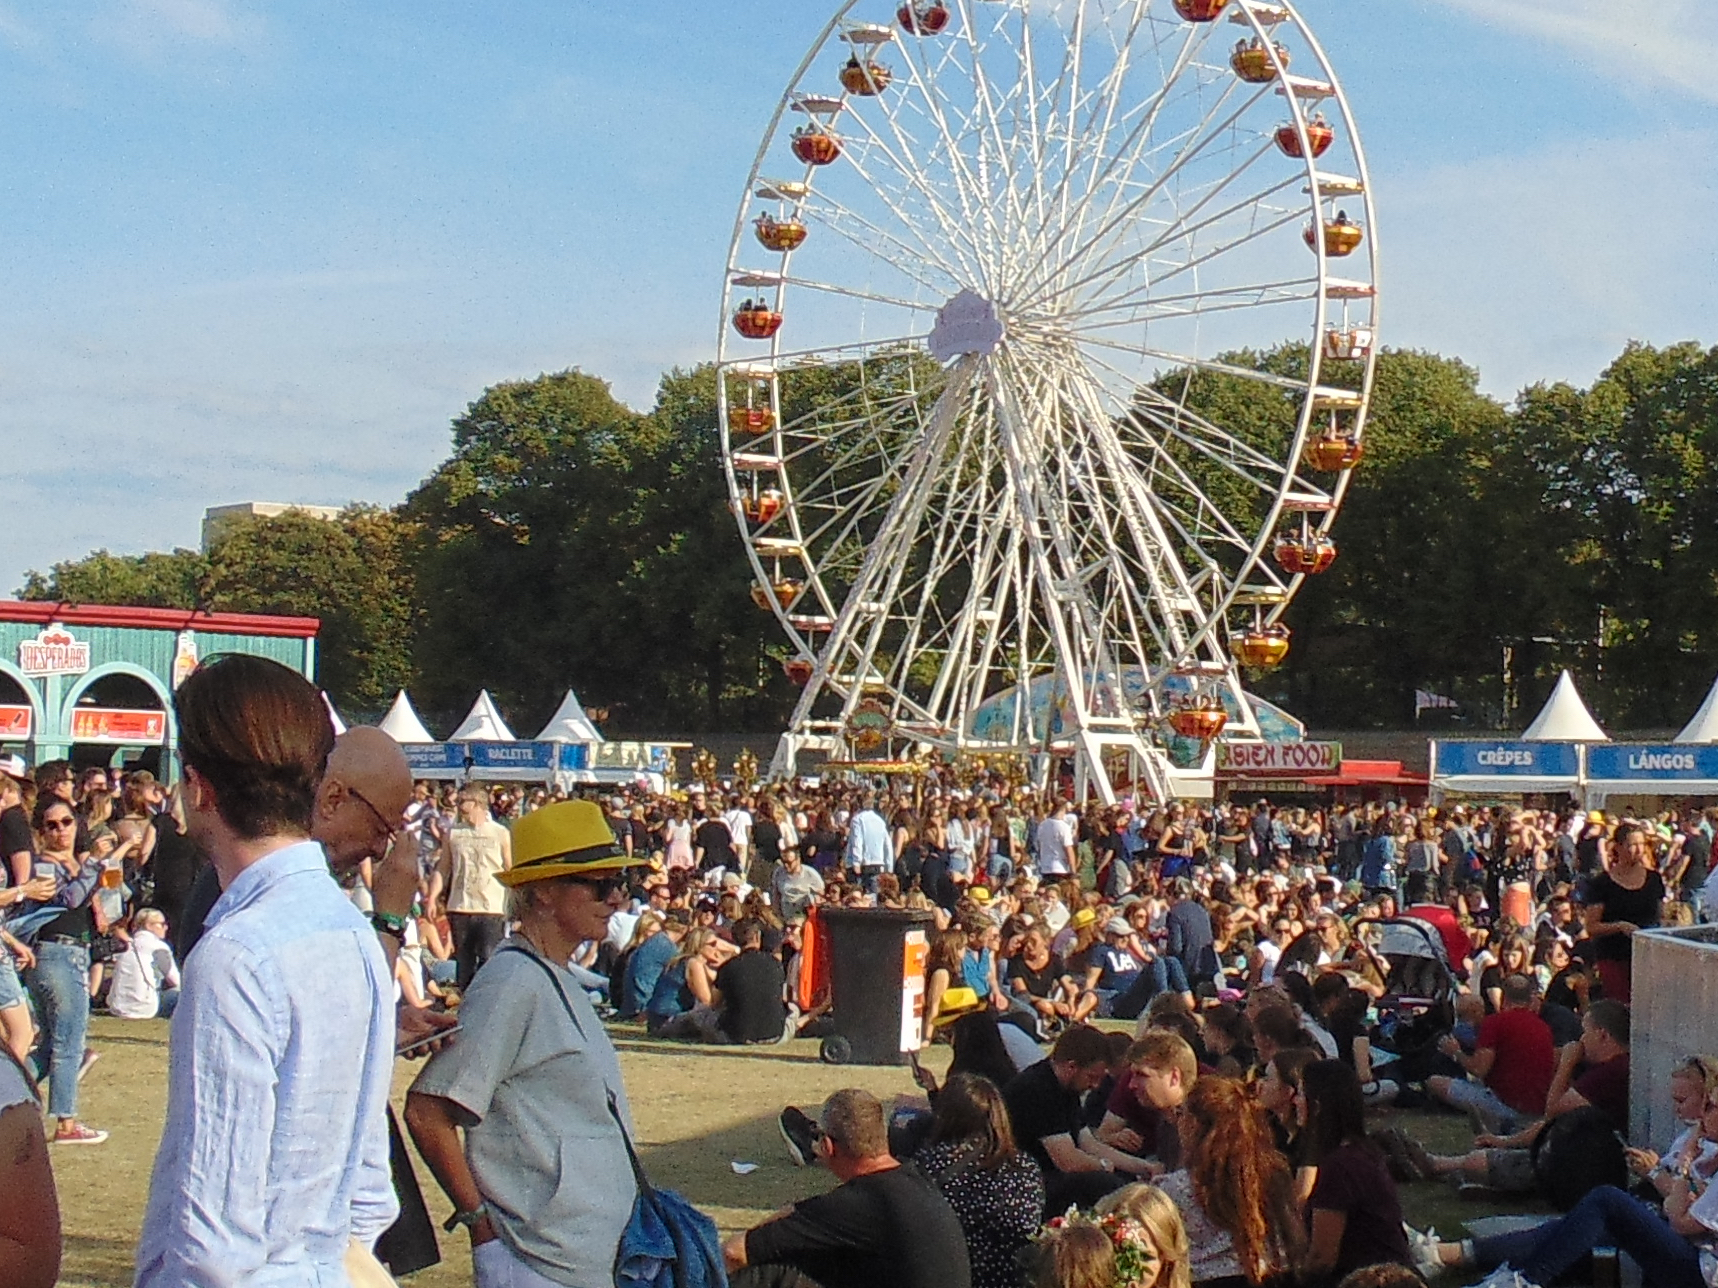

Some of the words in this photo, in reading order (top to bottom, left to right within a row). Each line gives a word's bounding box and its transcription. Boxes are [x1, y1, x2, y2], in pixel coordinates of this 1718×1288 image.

[26, 644, 87, 670] DESPERADOS
[488, 748, 533, 760] RACLETTE
[1222, 744, 1276, 767] ASIEN
[1282, 743, 1333, 767] FOOD
[1477, 746, 1532, 766] CRÊPES
[1629, 748, 1695, 770] LÁNGOS
